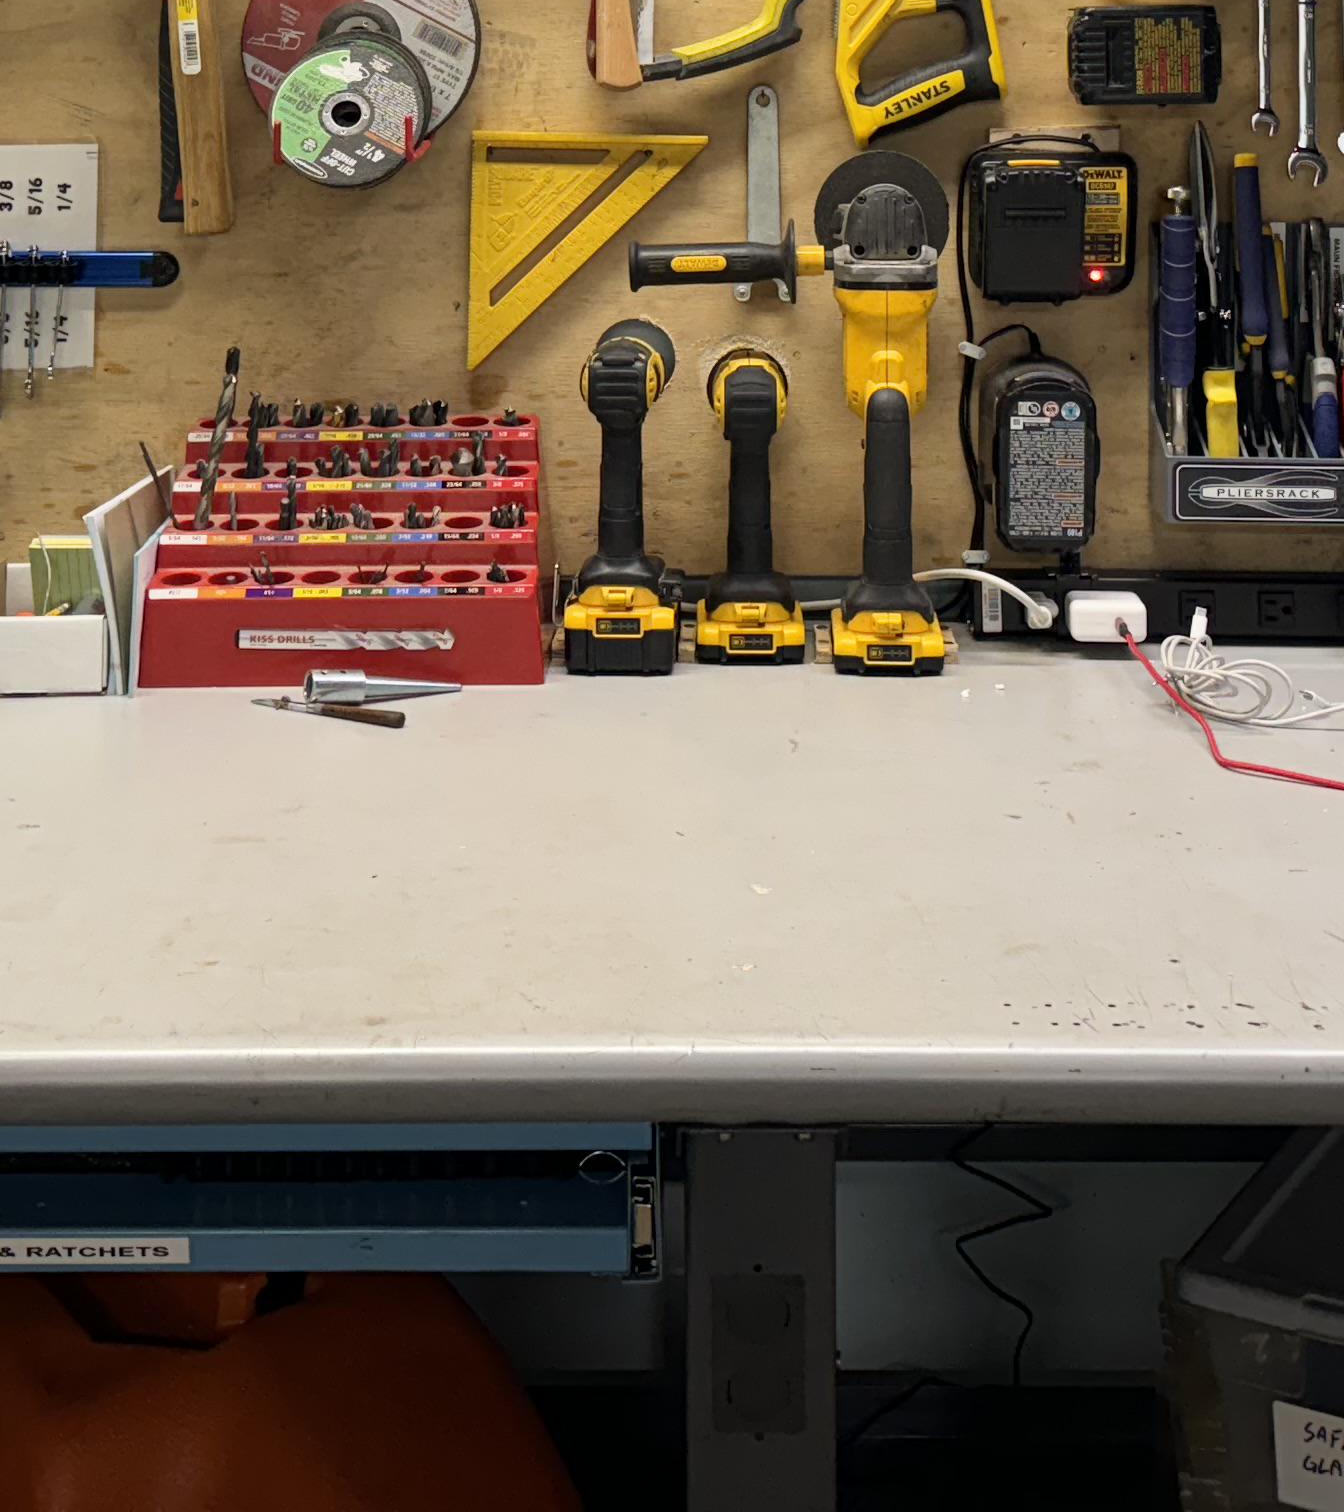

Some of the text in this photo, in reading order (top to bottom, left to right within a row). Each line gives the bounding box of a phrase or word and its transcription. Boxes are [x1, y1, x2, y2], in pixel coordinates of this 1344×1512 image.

[883, 79, 952, 120] STANLEY
[0, 180, 14, 212] 3/8
[28, 177, 43, 215] 5/16
[57, 183, 72, 211] 1/4
[1216, 487, 1320, 499] PLIERSRACK
[249, 635, 315, 644] KISS DRILLS
[26, 1246, 170, 1258] RATCHETS
